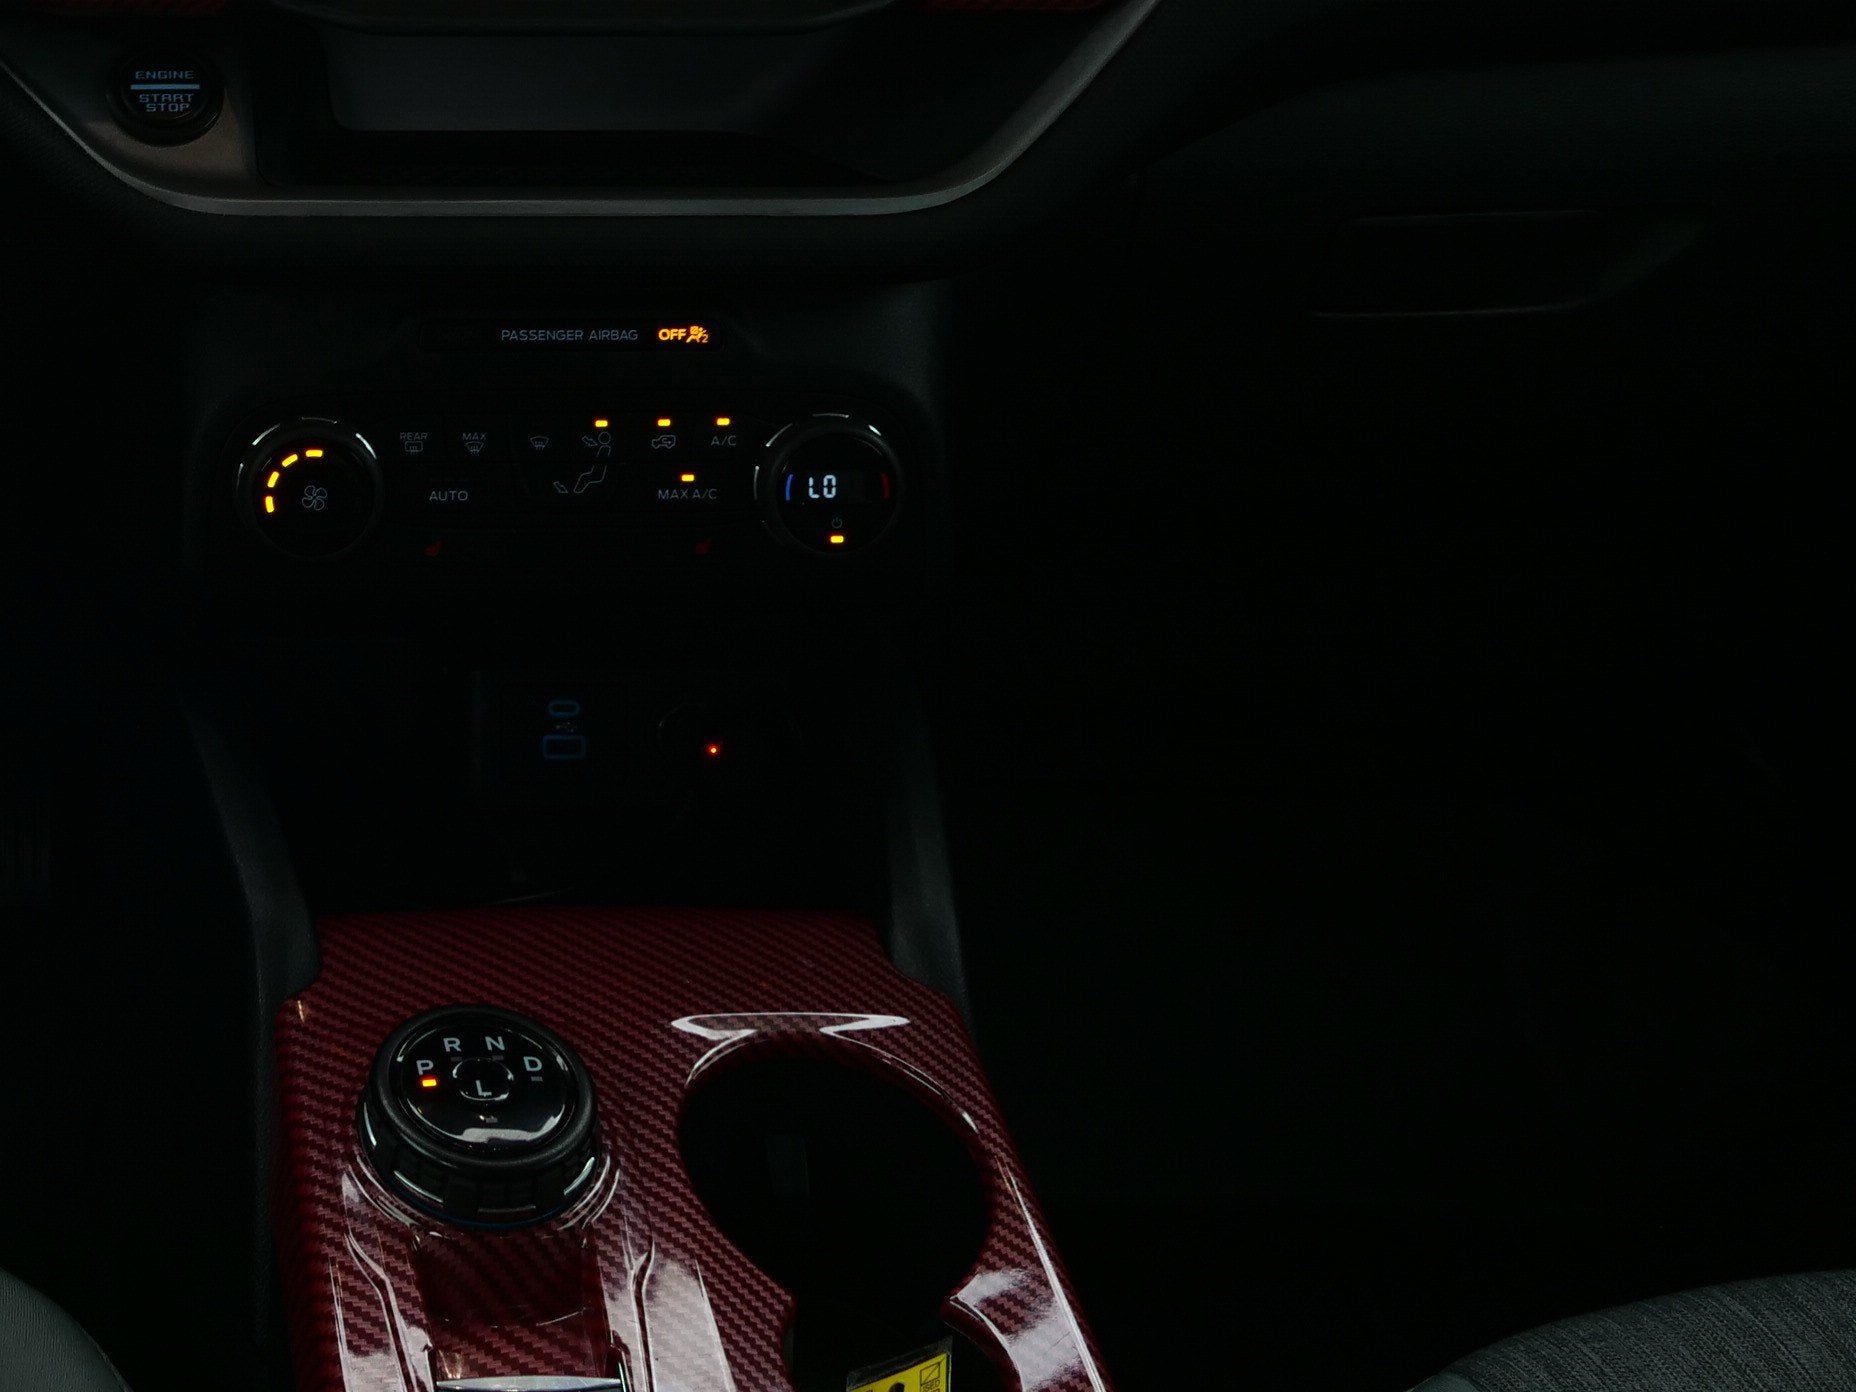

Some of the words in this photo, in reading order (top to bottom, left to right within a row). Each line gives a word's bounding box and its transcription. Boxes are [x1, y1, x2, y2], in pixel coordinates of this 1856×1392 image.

[134, 70, 194, 80] ENGINE
[138, 93, 194, 103] START
[145, 102, 190, 112] STOP
[501, 329, 583, 341] PASSENGER
[589, 329, 639, 341] AIRBAG
[658, 328, 686, 341] OFF
[400, 432, 428, 441] REAR
[462, 432, 487, 441] MAX
[711, 436, 736, 447] A/C
[429, 490, 468, 501] AUTO
[657, 489, 686, 500] MAX
[692, 489, 718, 500] A/C
[443, 1037, 462, 1052] R
[484, 1035, 506, 1051] N
[416, 1059, 434, 1075] P
[523, 1056, 543, 1072] D
[475, 1079, 492, 1096] L
